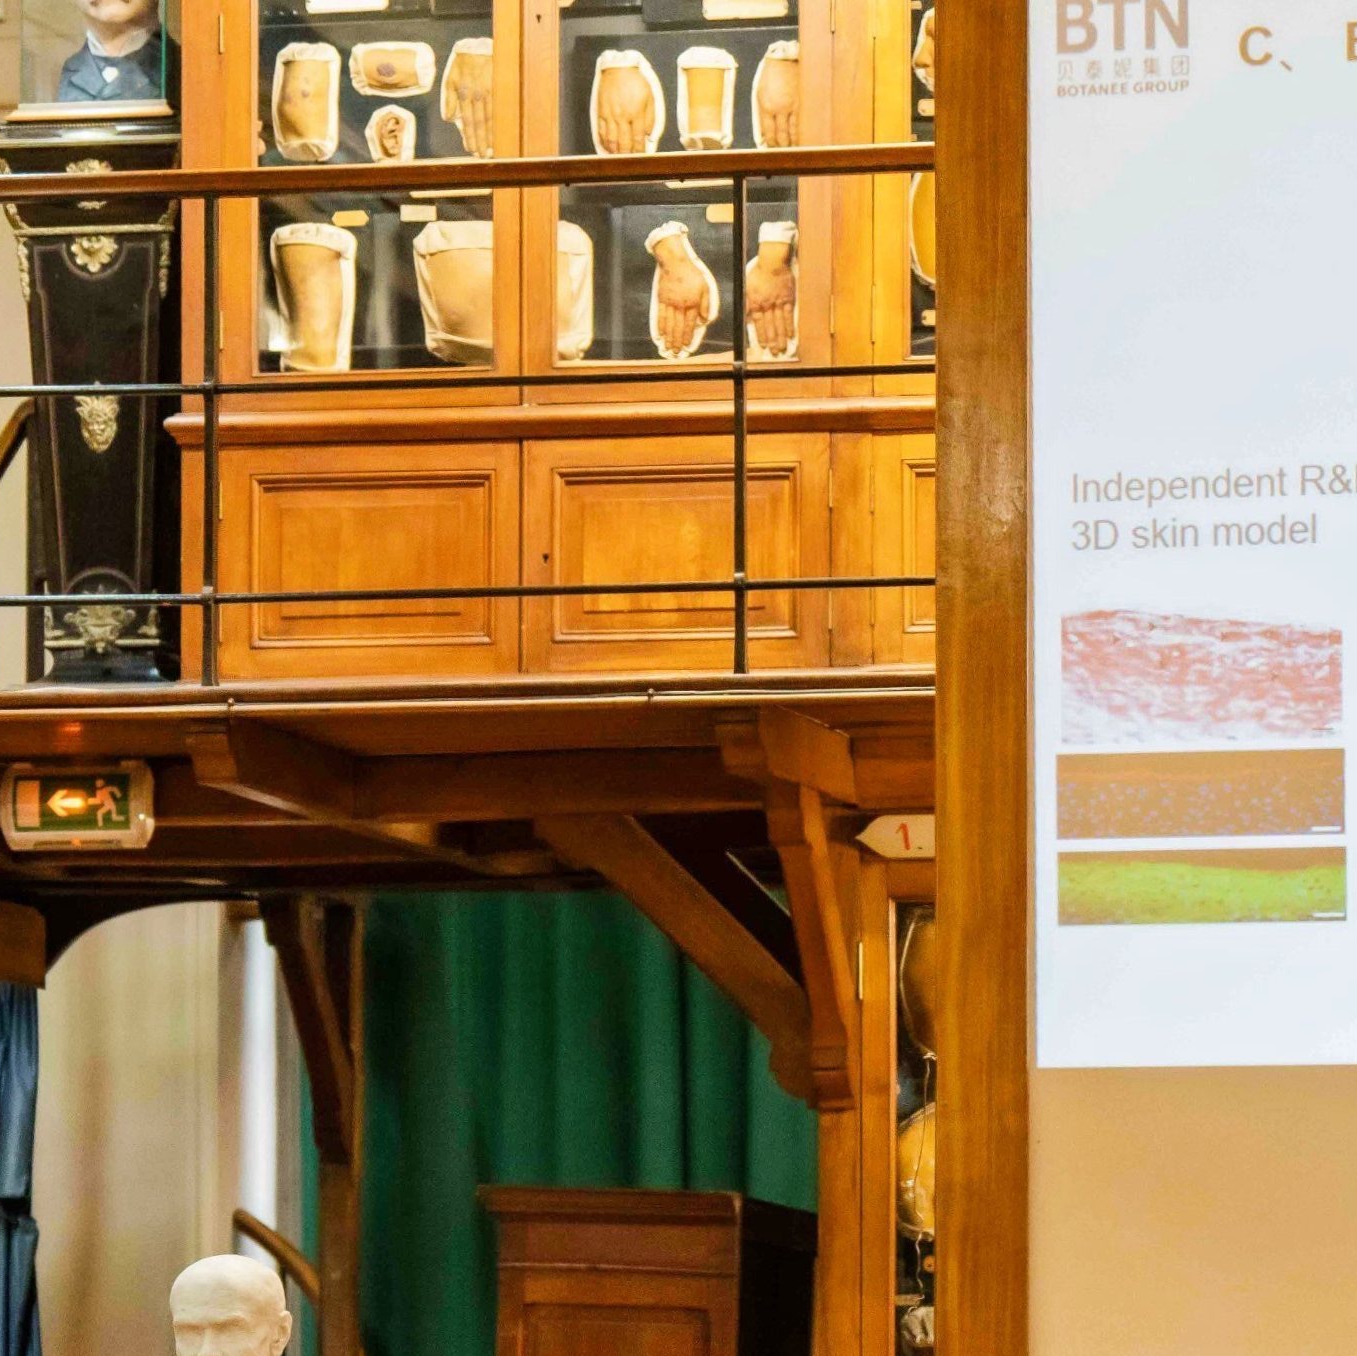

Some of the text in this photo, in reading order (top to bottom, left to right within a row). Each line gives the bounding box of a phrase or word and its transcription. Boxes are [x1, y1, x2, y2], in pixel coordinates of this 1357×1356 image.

[1056, 0, 1190, 54] BTN
[1056, 79, 1190, 97] BOTANEE GROUP
[1072, 468, 1287, 507] Independent
[1072, 513, 1317, 551] 3D skin model
